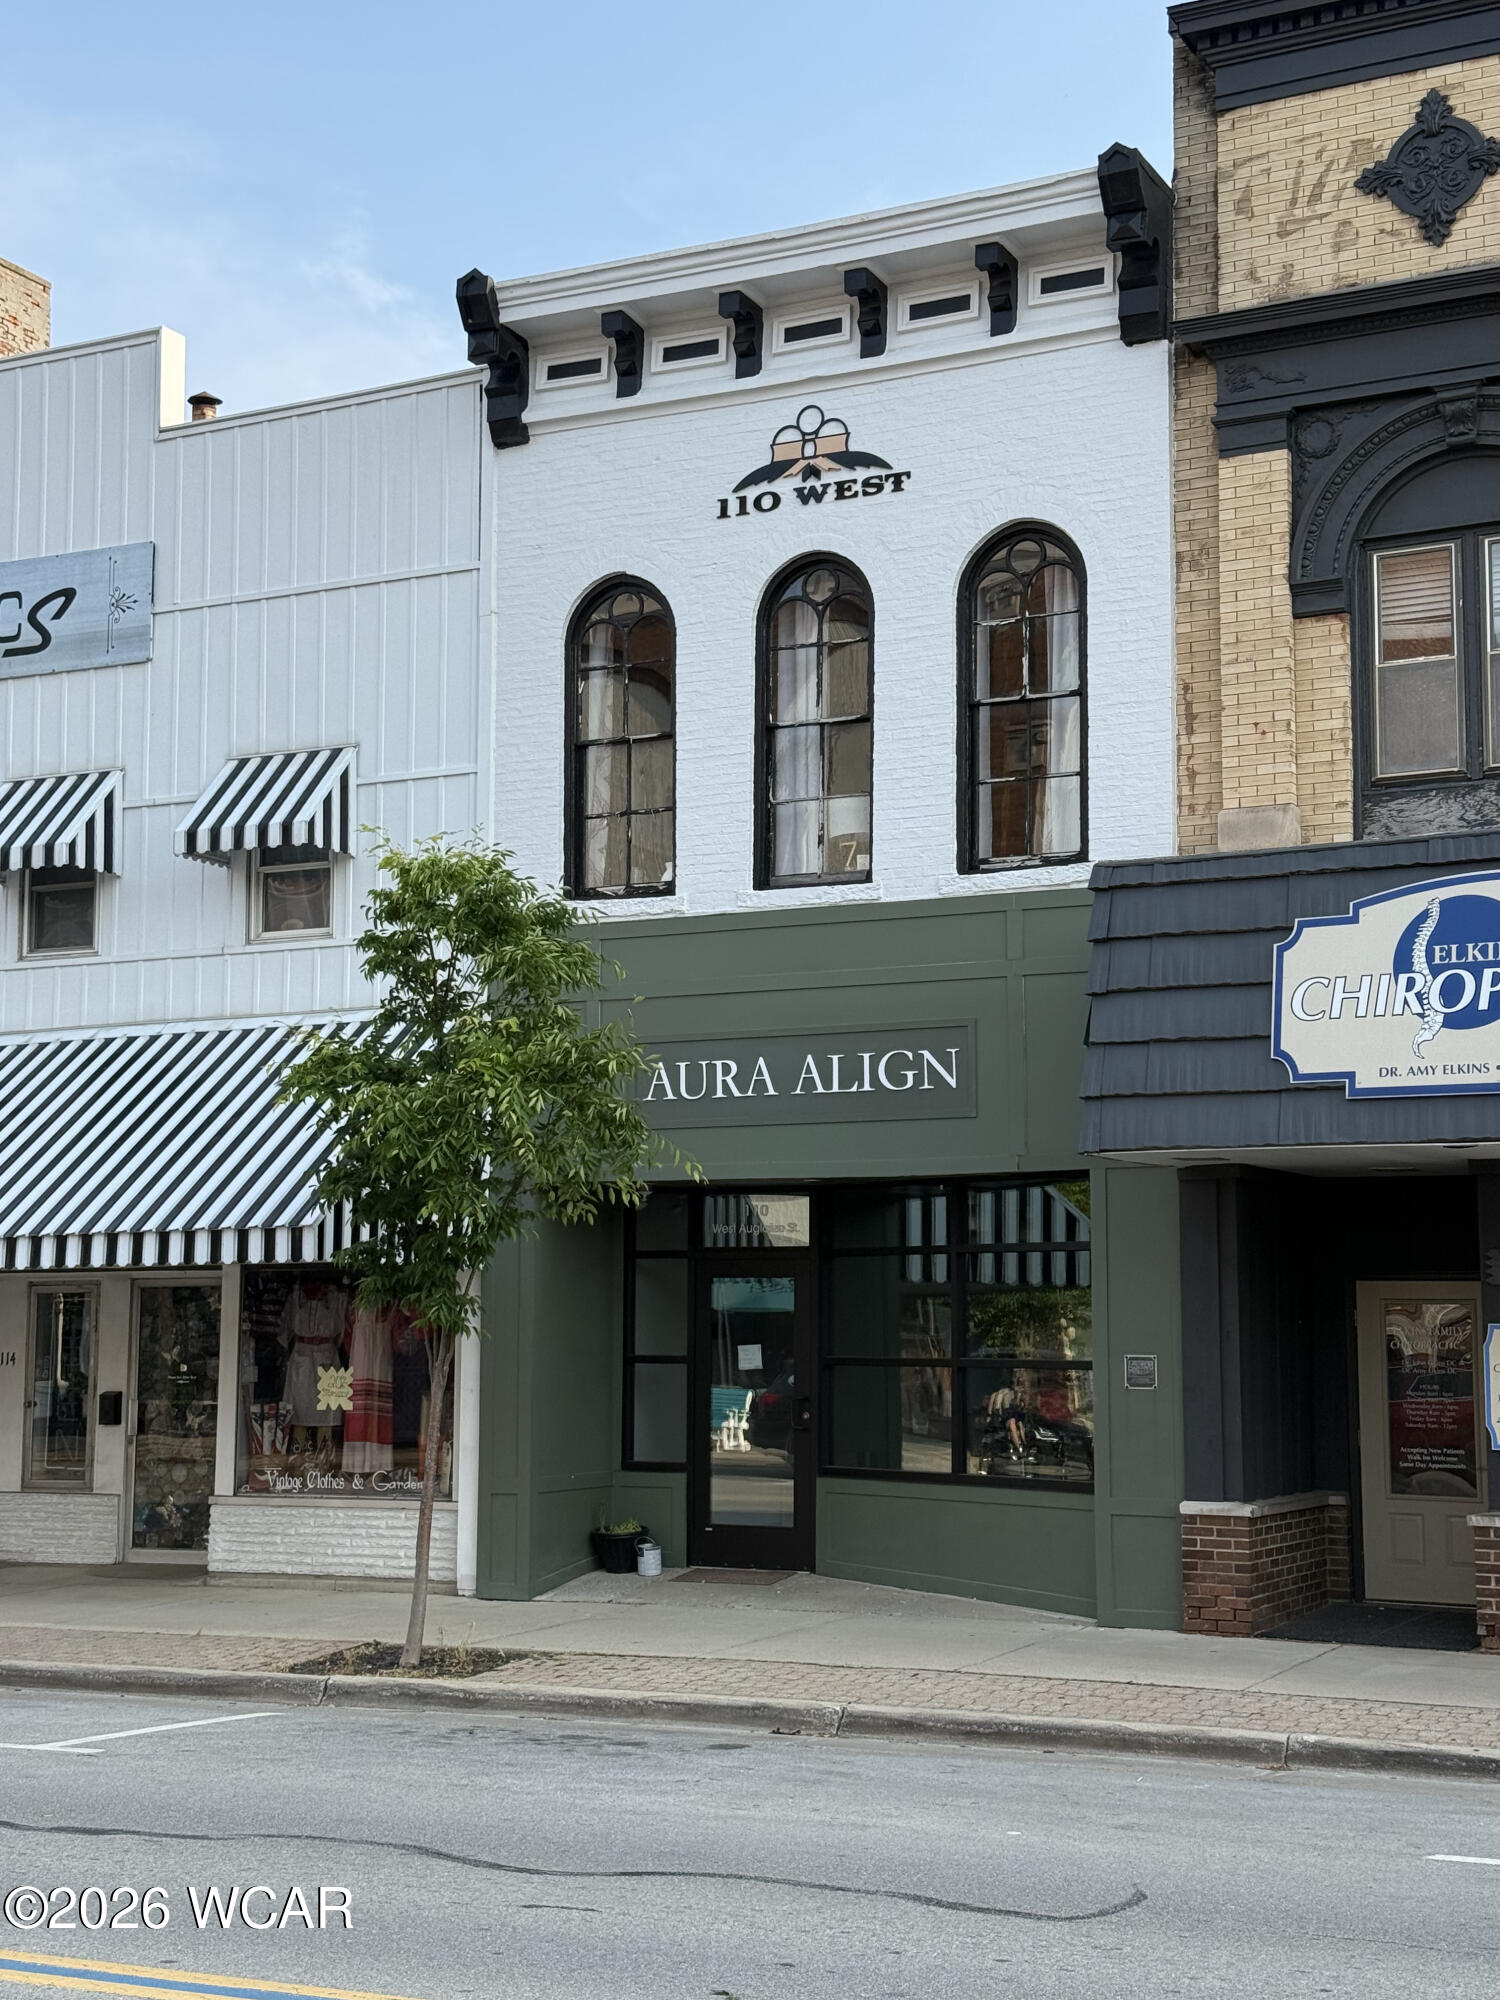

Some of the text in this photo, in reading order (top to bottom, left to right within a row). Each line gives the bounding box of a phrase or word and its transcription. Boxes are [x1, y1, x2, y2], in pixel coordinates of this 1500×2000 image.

[716, 470, 911, 519] 110 WEST
[1432, 941, 1500, 965] ELKI
[643, 1048, 960, 1101] AURA ALIGN
[1379, 1063, 1490, 1077] DR. AMY ELKINS
[712, 1223, 736, 1234] West
[1400, 1446, 1428, 1454] Accepting
[264, 1469, 304, 1493] Vintage
[304, 1470, 345, 1491] Clothes
[352, 1473, 364, 1490] &
